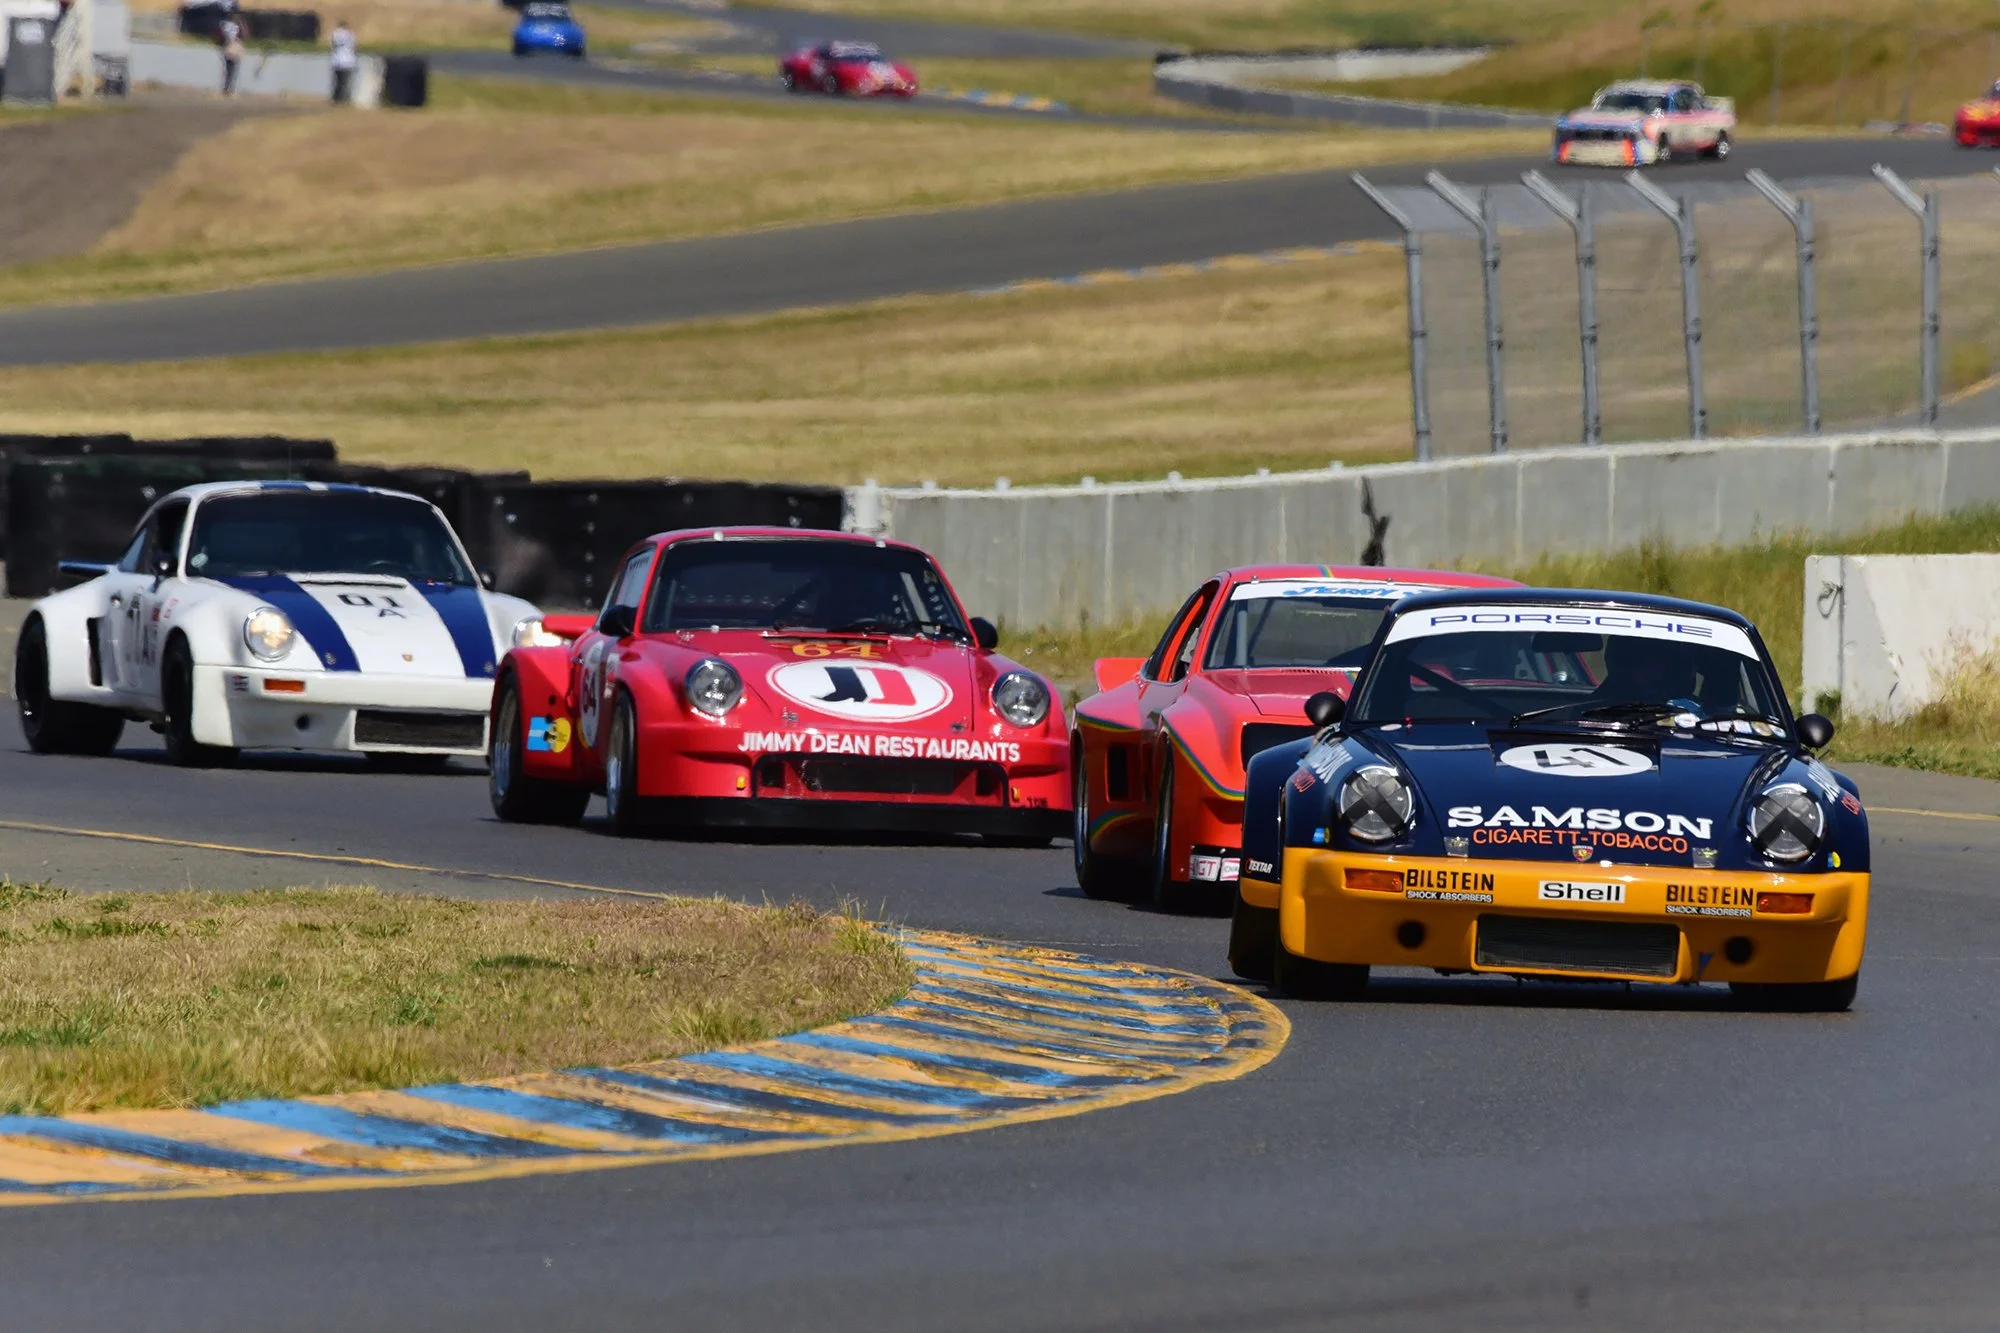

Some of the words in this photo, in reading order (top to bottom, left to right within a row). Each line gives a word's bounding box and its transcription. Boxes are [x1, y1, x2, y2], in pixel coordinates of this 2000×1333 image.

[1430, 613, 1713, 638] PORSCHE
[792, 642, 881, 659] 64
[738, 732, 806, 752] JIMMY
[810, 734, 871, 756] DEAN
[875, 736, 1021, 762] RESTAURANTS
[1533, 747, 1631, 768] 41
[1448, 805, 1713, 839] SAMSON
[1473, 828, 1688, 853] CIGARETT-TOBACCO
[1248, 860, 1274, 874] TEXTAR
[1406, 869, 1494, 891] BILSTEIN
[1407, 890, 1437, 900] SHOCK
[1440, 892, 1493, 903] ABSORBERS
[1543, 883, 1621, 901] Shell
[1666, 884, 1754, 906] BILSTEIN
[1667, 905, 1698, 914] SHOCK
[1700, 907, 1751, 917] ABSORBERS
